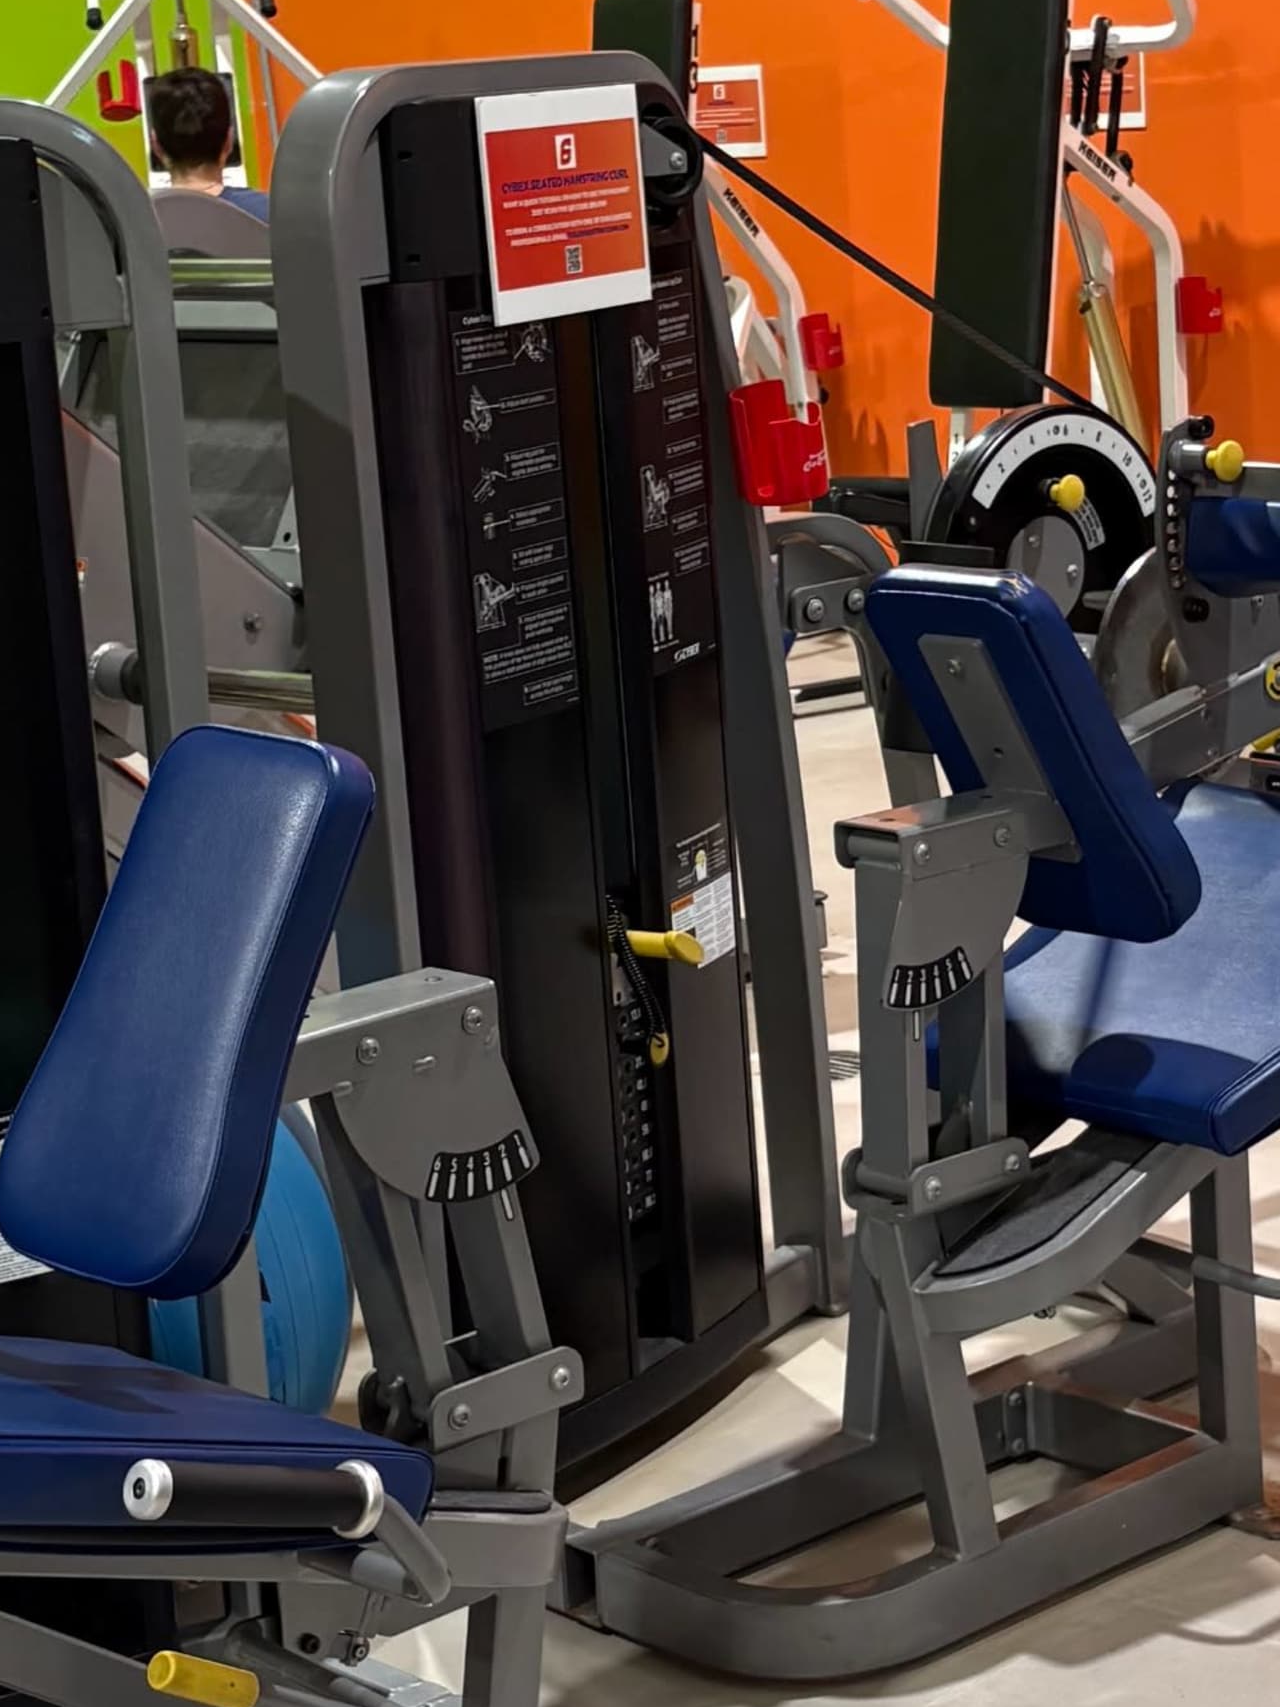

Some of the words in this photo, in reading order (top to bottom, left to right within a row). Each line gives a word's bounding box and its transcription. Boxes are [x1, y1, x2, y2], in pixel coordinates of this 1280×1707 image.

[561, 138, 572, 166] 6
[1078, 140, 1117, 182] KEISER
[723, 187, 761, 239] KEISER
[514, 1134, 521, 1146] 1
[498, 1143, 506, 1158] 2
[433, 1155, 441, 1171] 6
[450, 1157, 458, 1172] 5
[466, 1155, 474, 1170] 4
[483, 1151, 491, 1166] 3
